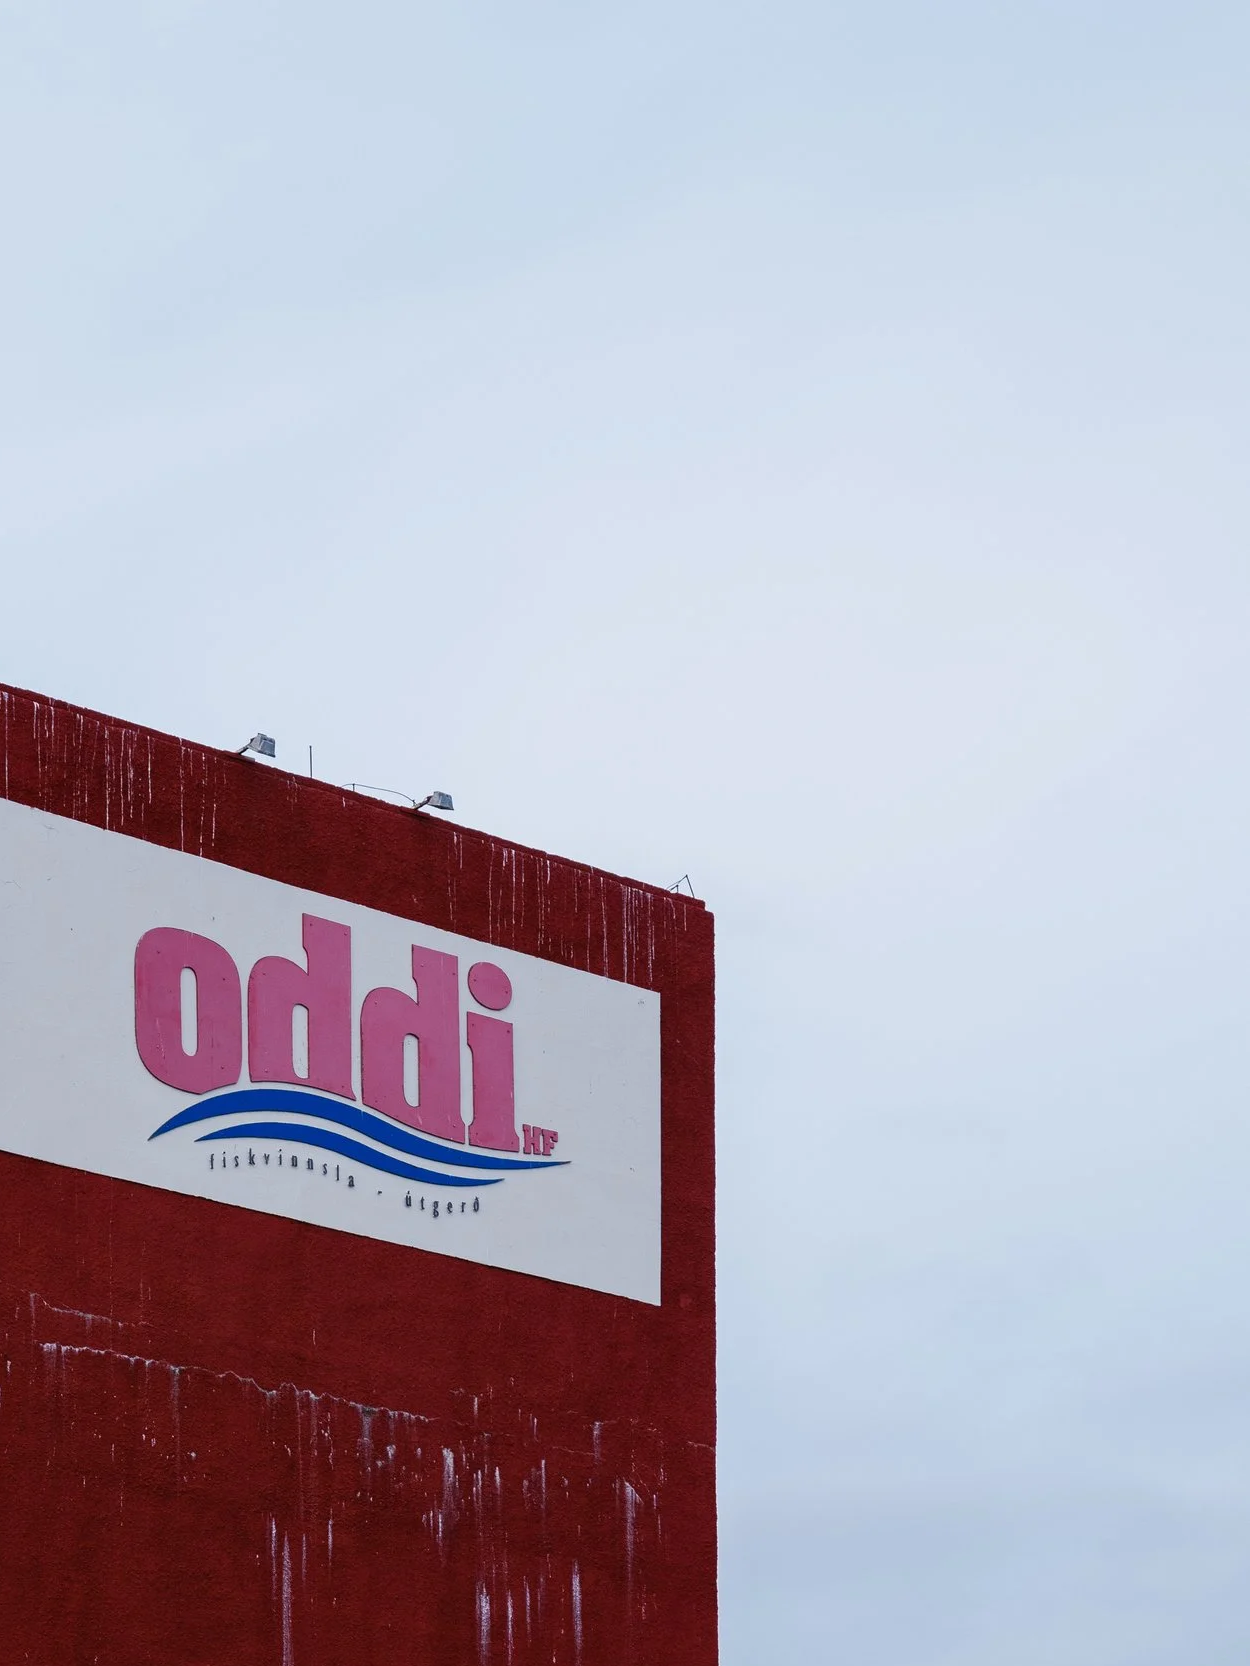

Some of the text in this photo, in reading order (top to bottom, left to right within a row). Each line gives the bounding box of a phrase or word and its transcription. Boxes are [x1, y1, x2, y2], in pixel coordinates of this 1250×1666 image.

[134, 913, 558, 1156] oddi HF
[208, 1147, 355, 1188] fiskvinnsla
[405, 1190, 480, 1218] útgerð
